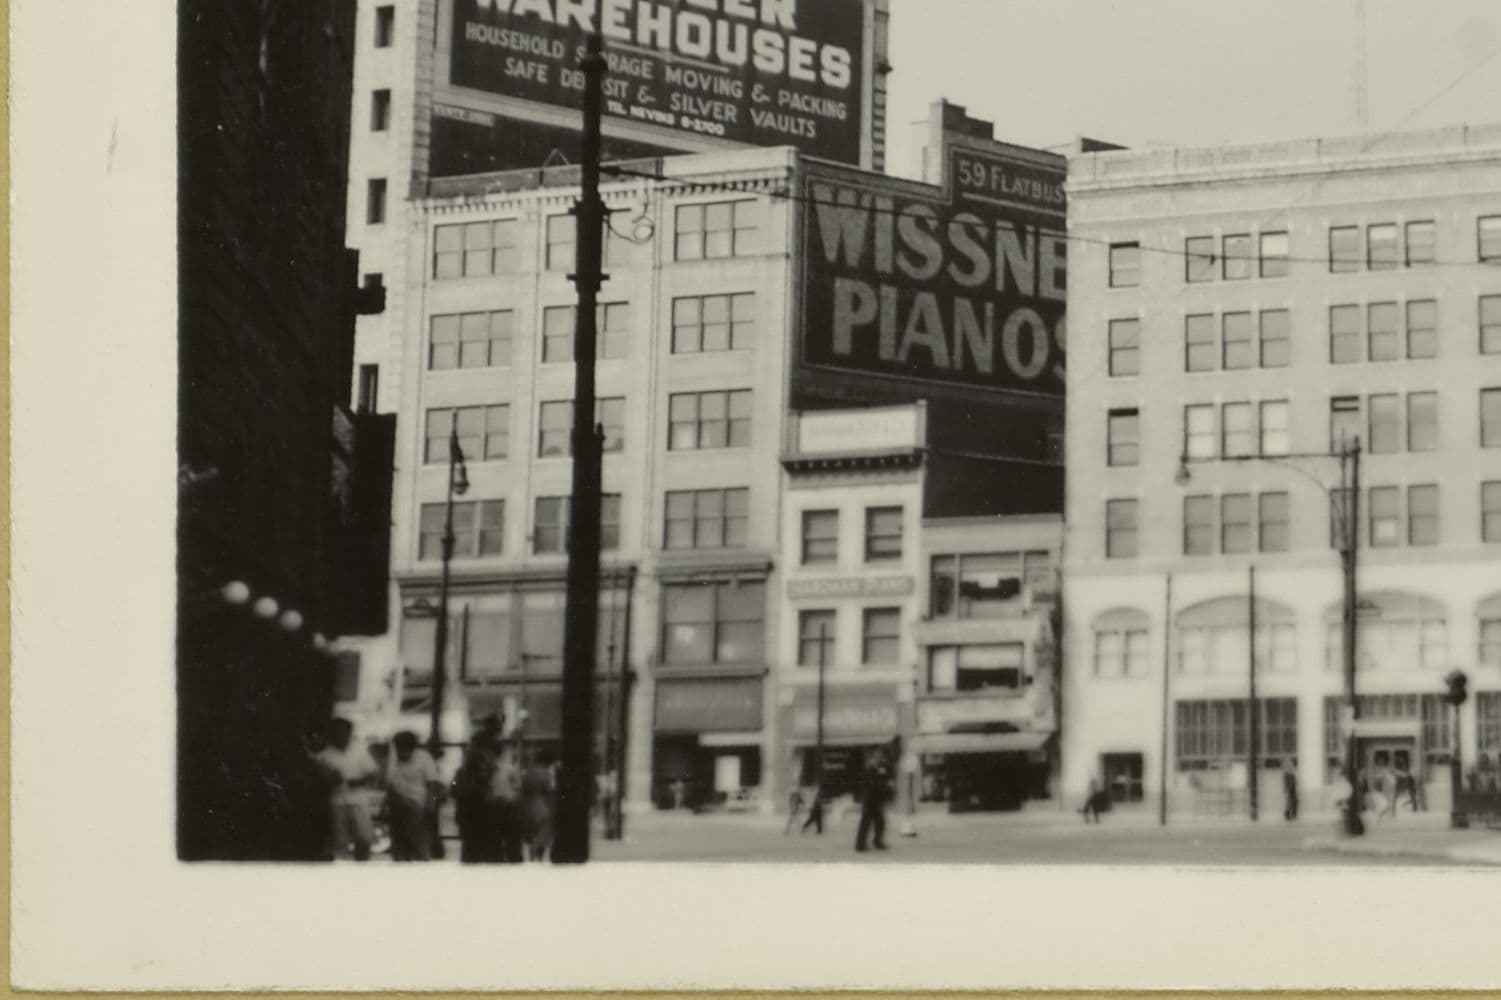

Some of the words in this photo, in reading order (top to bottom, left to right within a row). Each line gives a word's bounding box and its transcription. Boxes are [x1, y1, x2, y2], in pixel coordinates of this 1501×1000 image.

[465, 21, 565, 58] HOUSEHOLD
[575, 45, 653, 79] SRAGE
[665, 65, 743, 98] MOVING
[751, 83, 771, 103] &
[778, 89, 847, 120] PACKING
[504, 57, 549, 83] SAFE
[560, 68, 629, 99] DESIT
[637, 85, 656, 104] &
[670, 92, 737, 122] SILVER
[749, 108, 817, 138] VAULTS
[959, 159, 986, 188] 59
